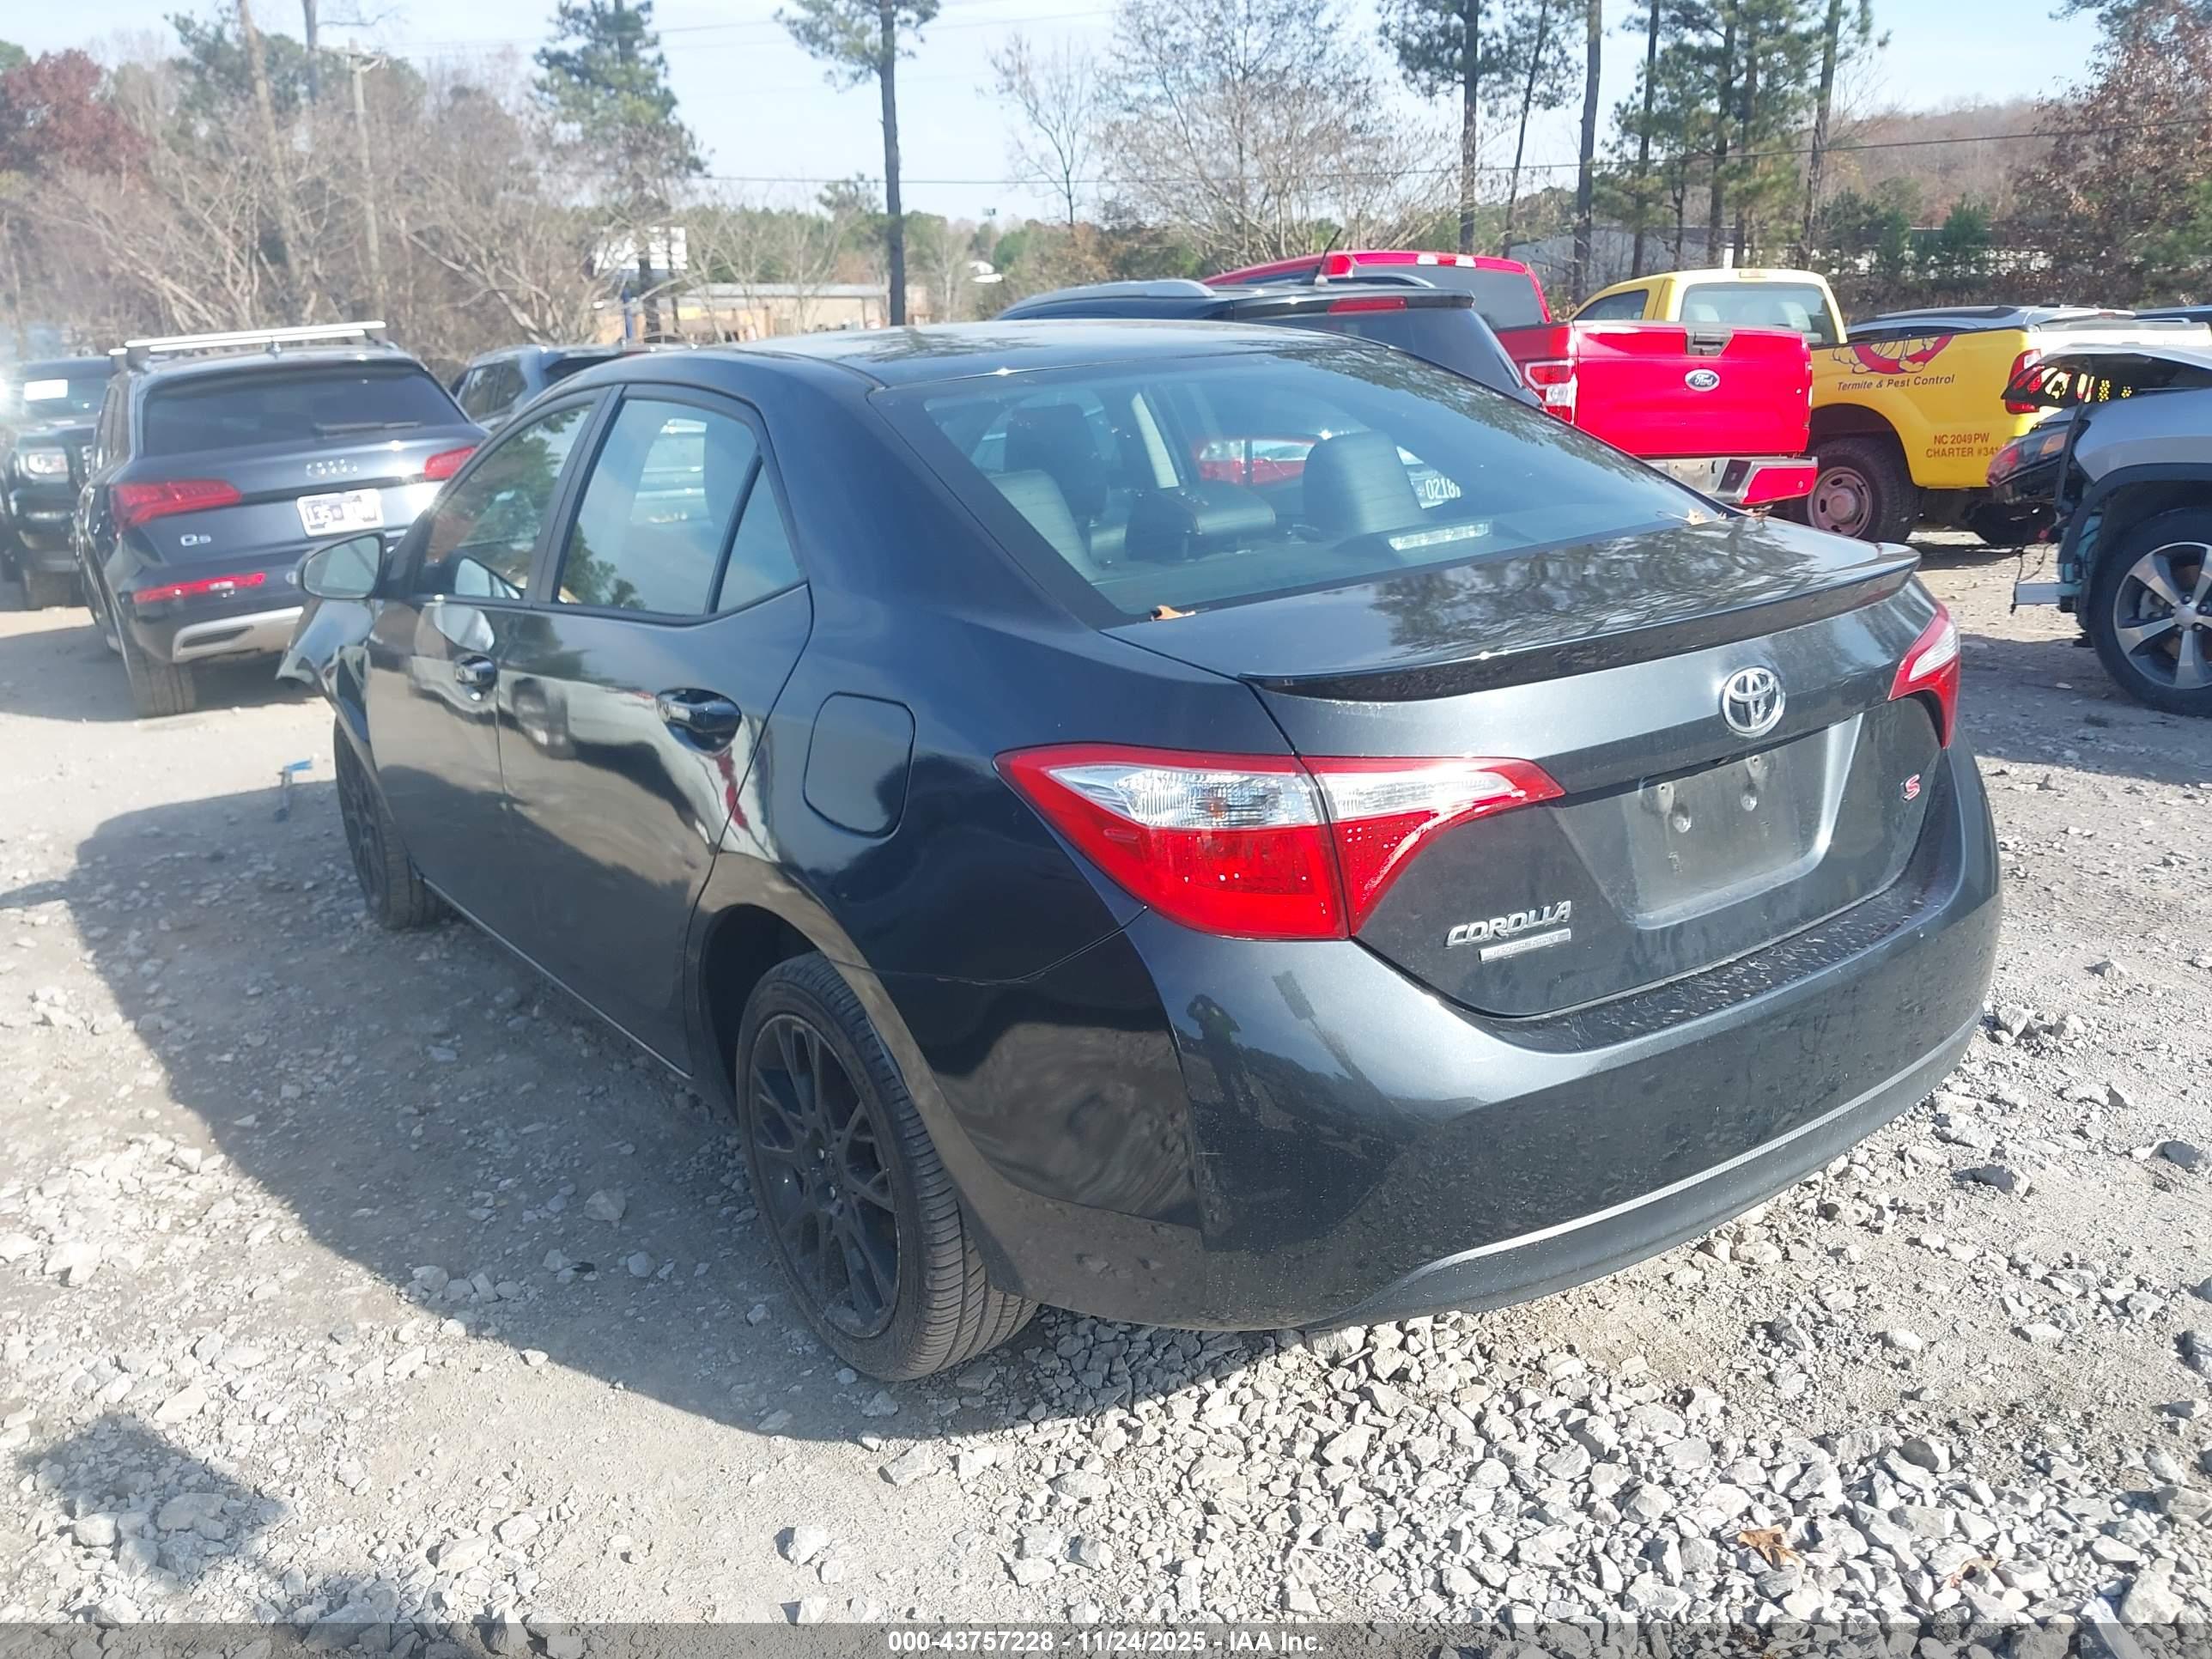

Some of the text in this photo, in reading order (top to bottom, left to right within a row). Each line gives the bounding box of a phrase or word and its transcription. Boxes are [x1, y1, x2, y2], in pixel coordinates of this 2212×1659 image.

[1838, 374, 1955, 392] Termite & Pest Control
[1934, 433, 1990, 445] NC 2049 PW
[1926, 447, 1973, 458] CHARTER
[1904, 774, 1920, 800] S
[1446, 900, 1572, 948] COROLLA
